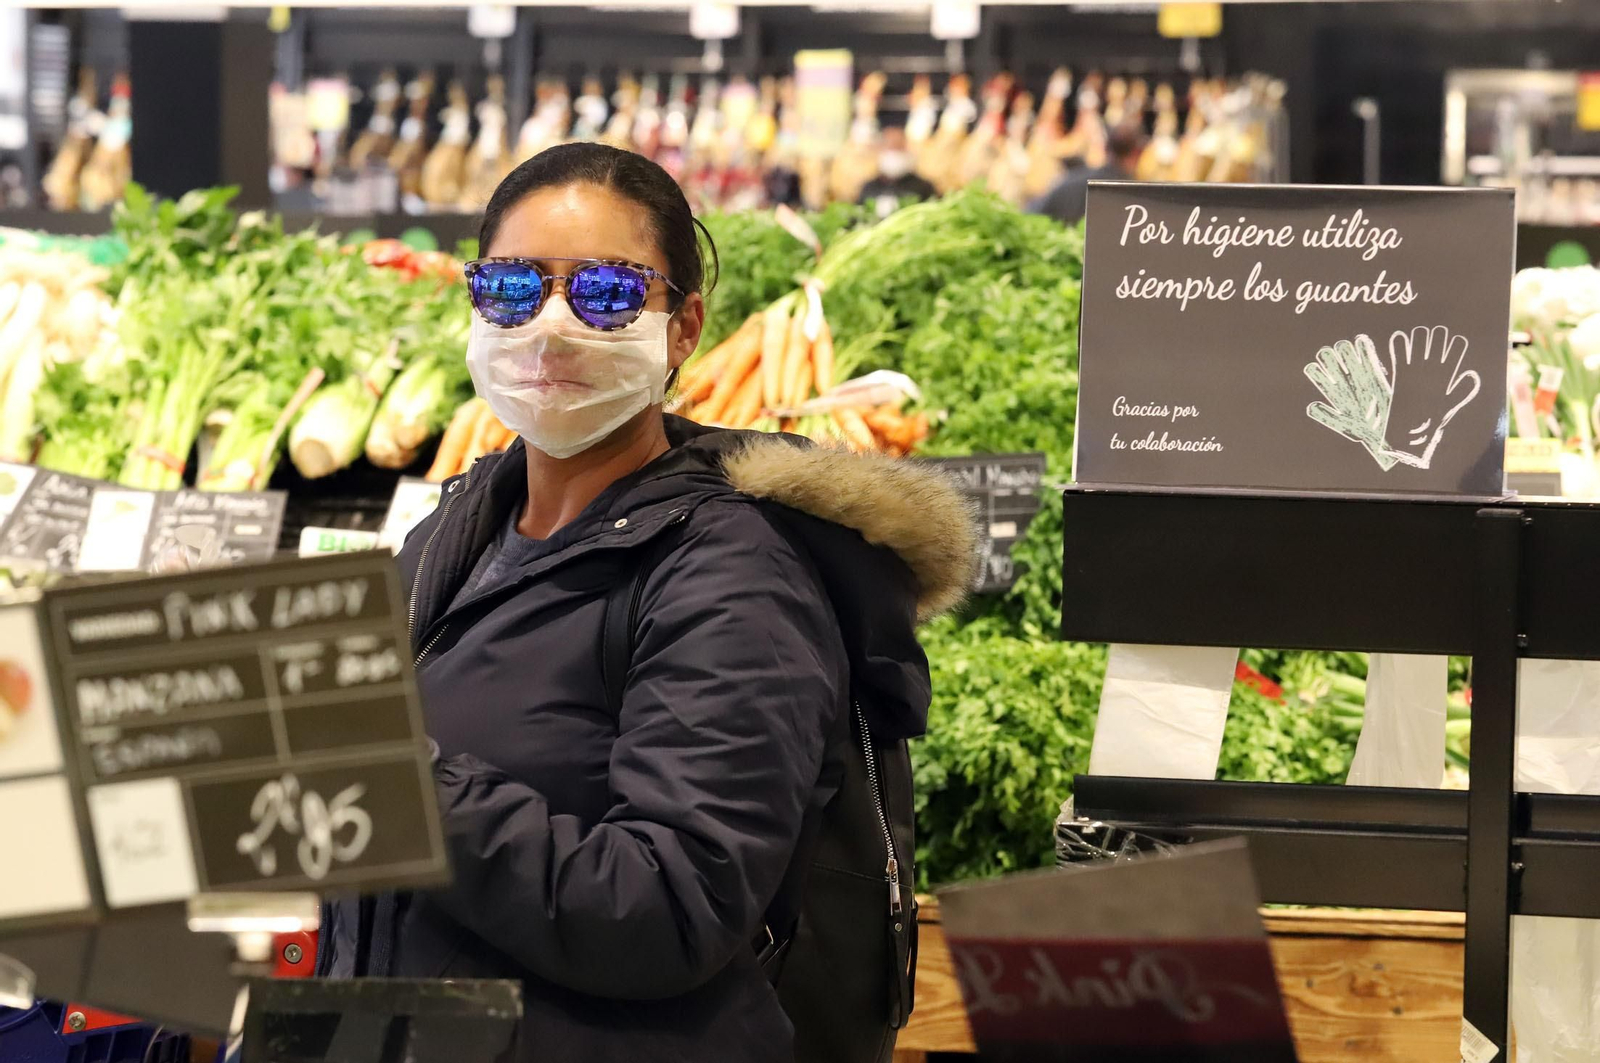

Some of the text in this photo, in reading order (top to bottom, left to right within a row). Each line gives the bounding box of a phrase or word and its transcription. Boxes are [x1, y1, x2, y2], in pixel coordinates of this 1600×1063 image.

[1120, 204, 1403, 261] Por higiene utiliza
[1116, 261, 1418, 314] siempre los guantes
[1112, 395, 1200, 423] Gracias por
[1109, 430, 1224, 452] tu colaboración
